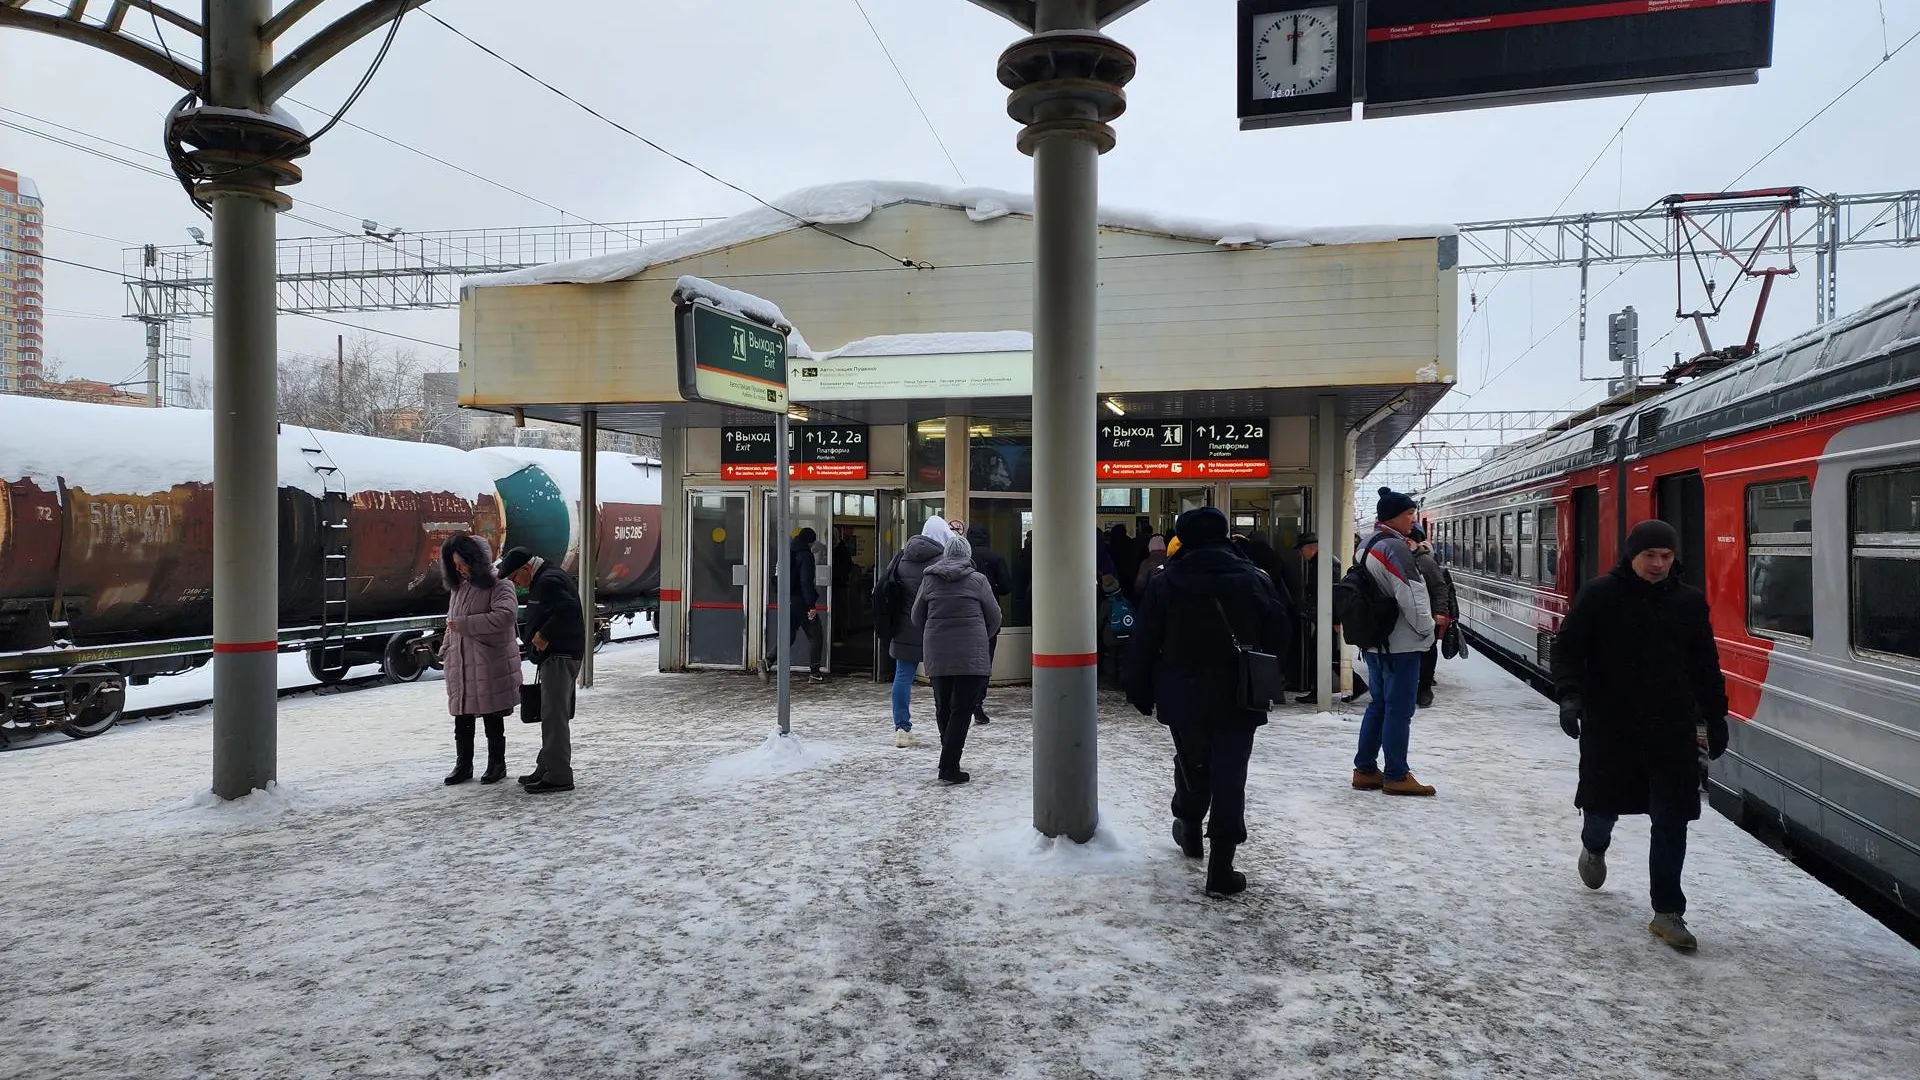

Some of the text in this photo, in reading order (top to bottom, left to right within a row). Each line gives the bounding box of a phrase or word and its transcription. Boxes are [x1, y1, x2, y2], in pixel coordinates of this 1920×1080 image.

[748, 331, 776, 357] Выход
[764, 356, 776, 370] Exit
[735, 430, 771, 442] Выход
[816, 430, 862, 446] 1, 2, 2а
[1112, 425, 1154, 438] Выход
[1208, 424, 1264, 441] 1, 2, 2а
[735, 443, 751, 452] Exit
[1112, 438, 1131, 448] Exit
[816, 447, 850, 455] Платформа
[37, 506, 53, 522] 72
